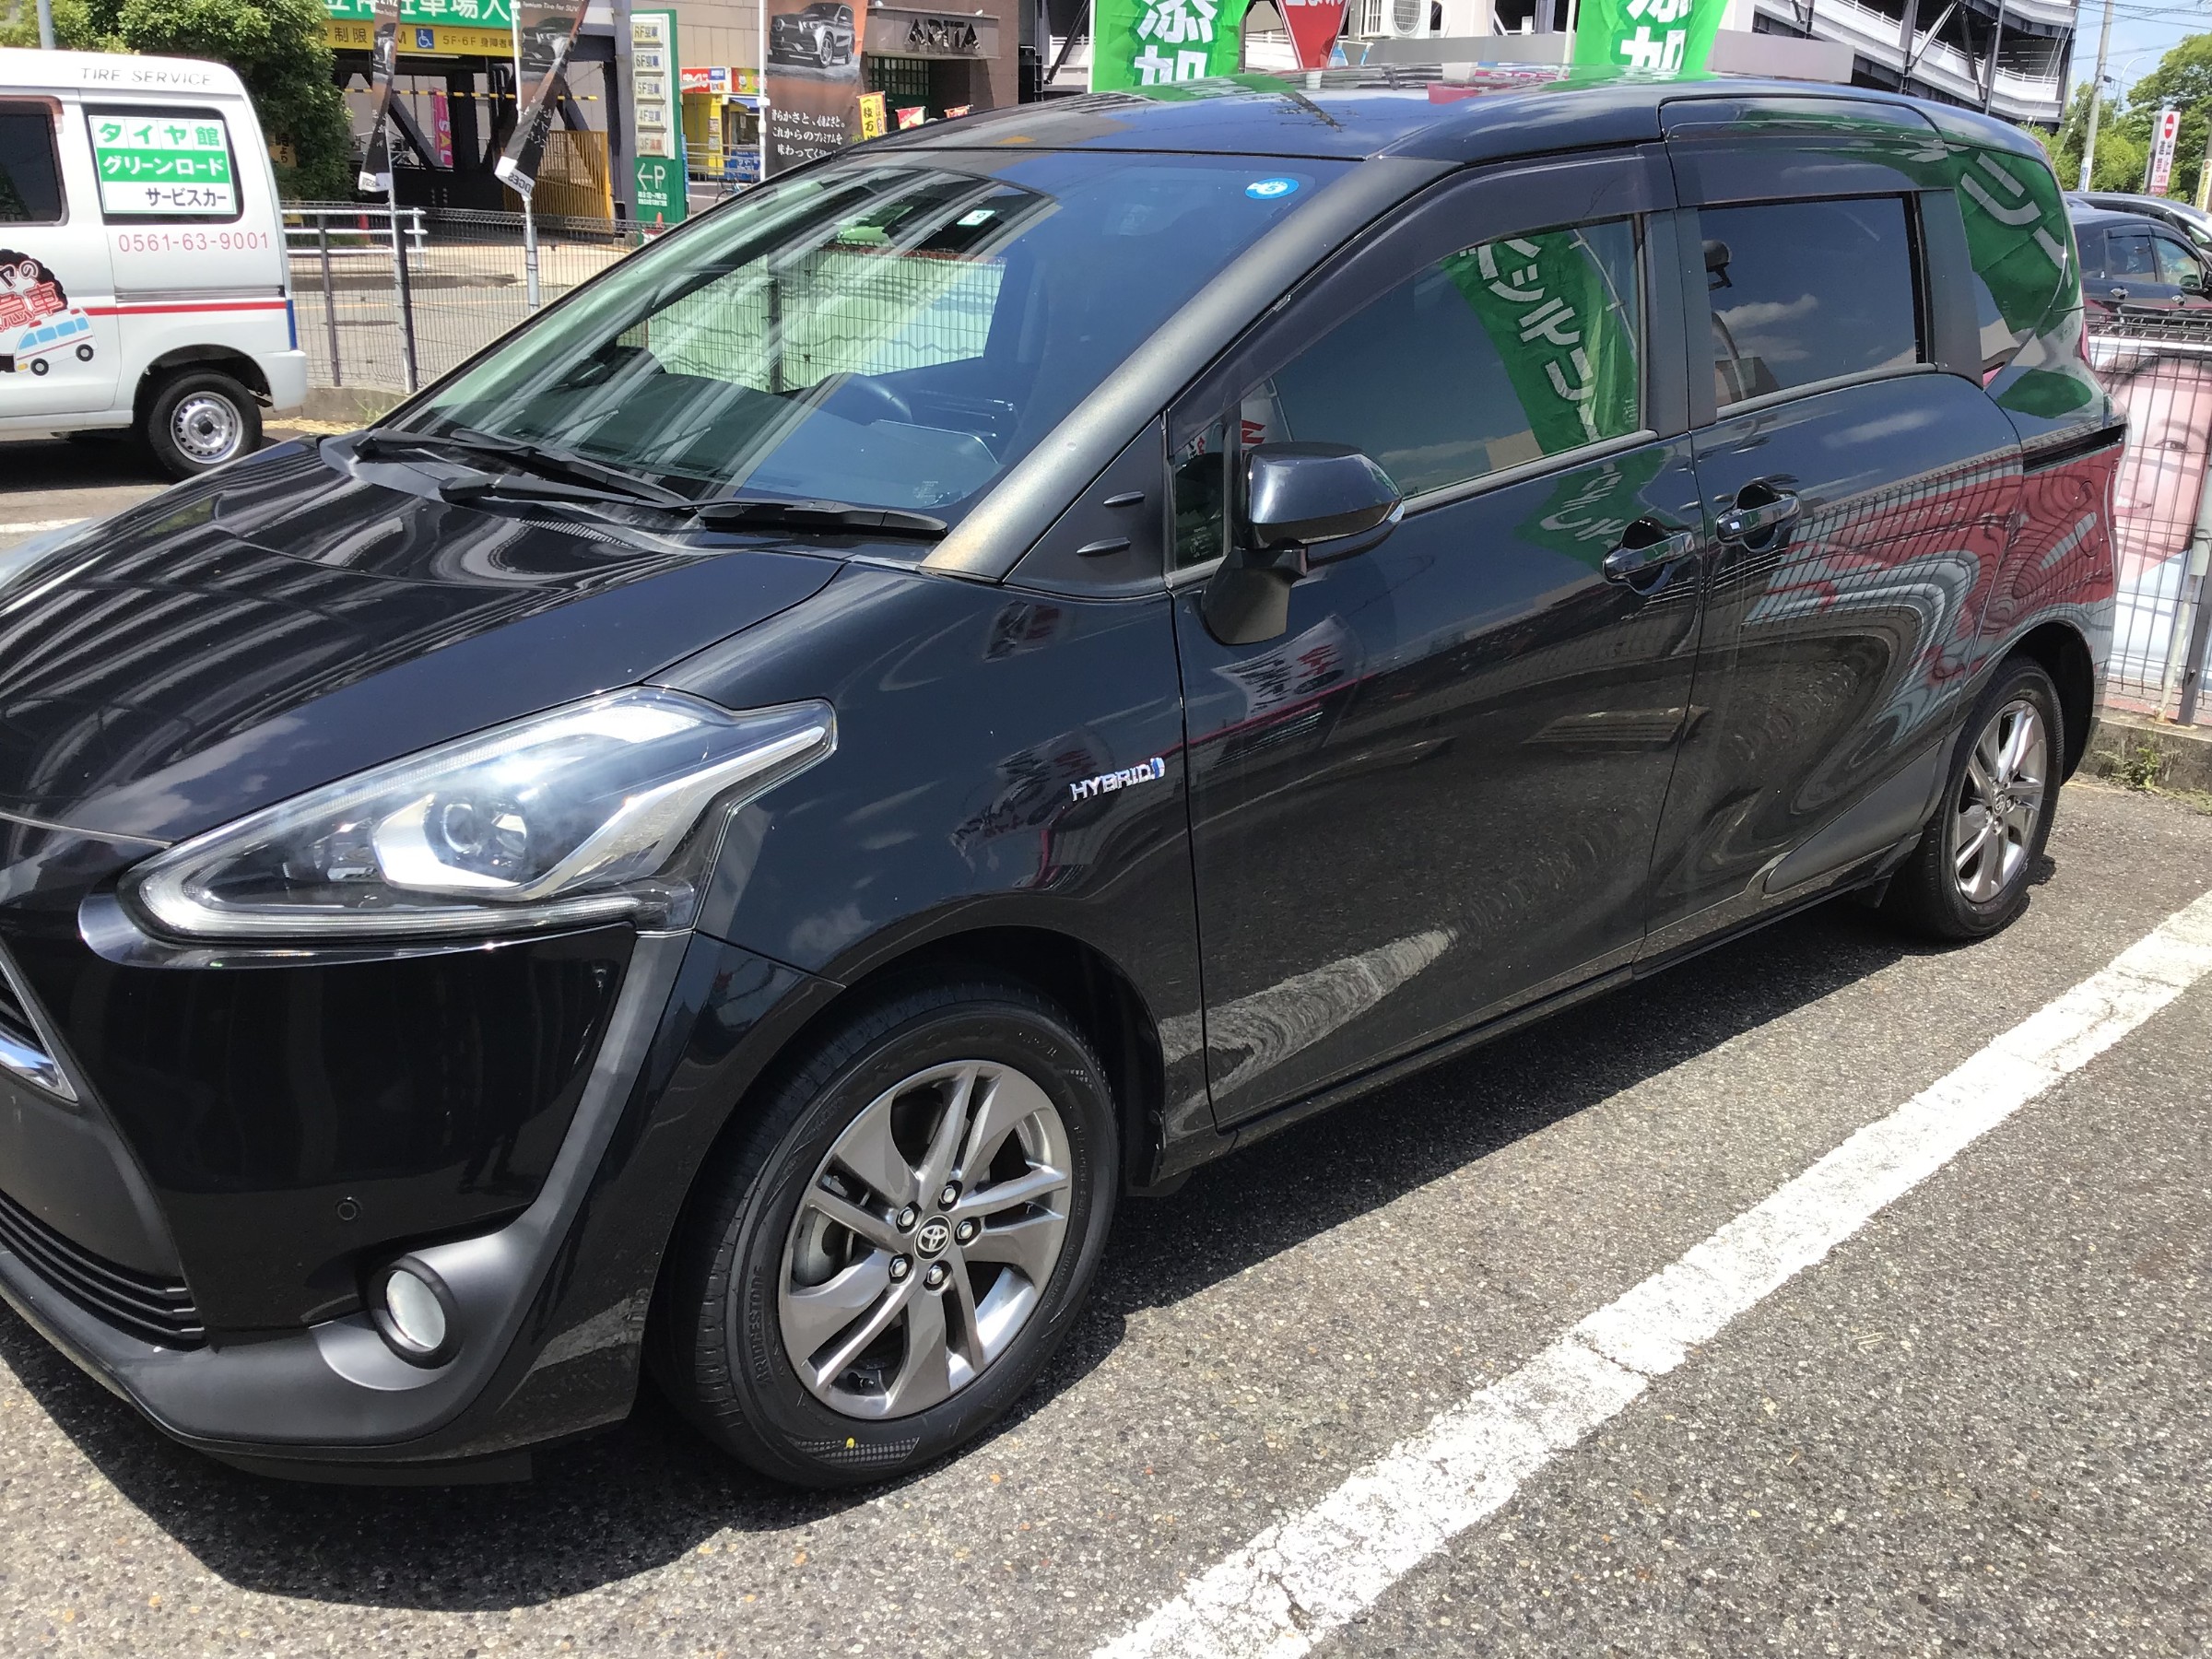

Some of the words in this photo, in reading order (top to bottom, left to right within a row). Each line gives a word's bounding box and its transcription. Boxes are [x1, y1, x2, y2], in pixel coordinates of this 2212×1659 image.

[565, 4, 580, 13] SUV
[81, 67, 122, 81] TIRE
[132, 70, 213, 87] SERVICE
[99, 123, 220, 147] タイヤ館
[102, 155, 224, 176] グリーンロード
[653, 164, 666, 190] P
[145, 187, 228, 207] サービスカー
[118, 231, 269, 253] 0561-63-9001
[1070, 763, 1156, 802] HYBRID
